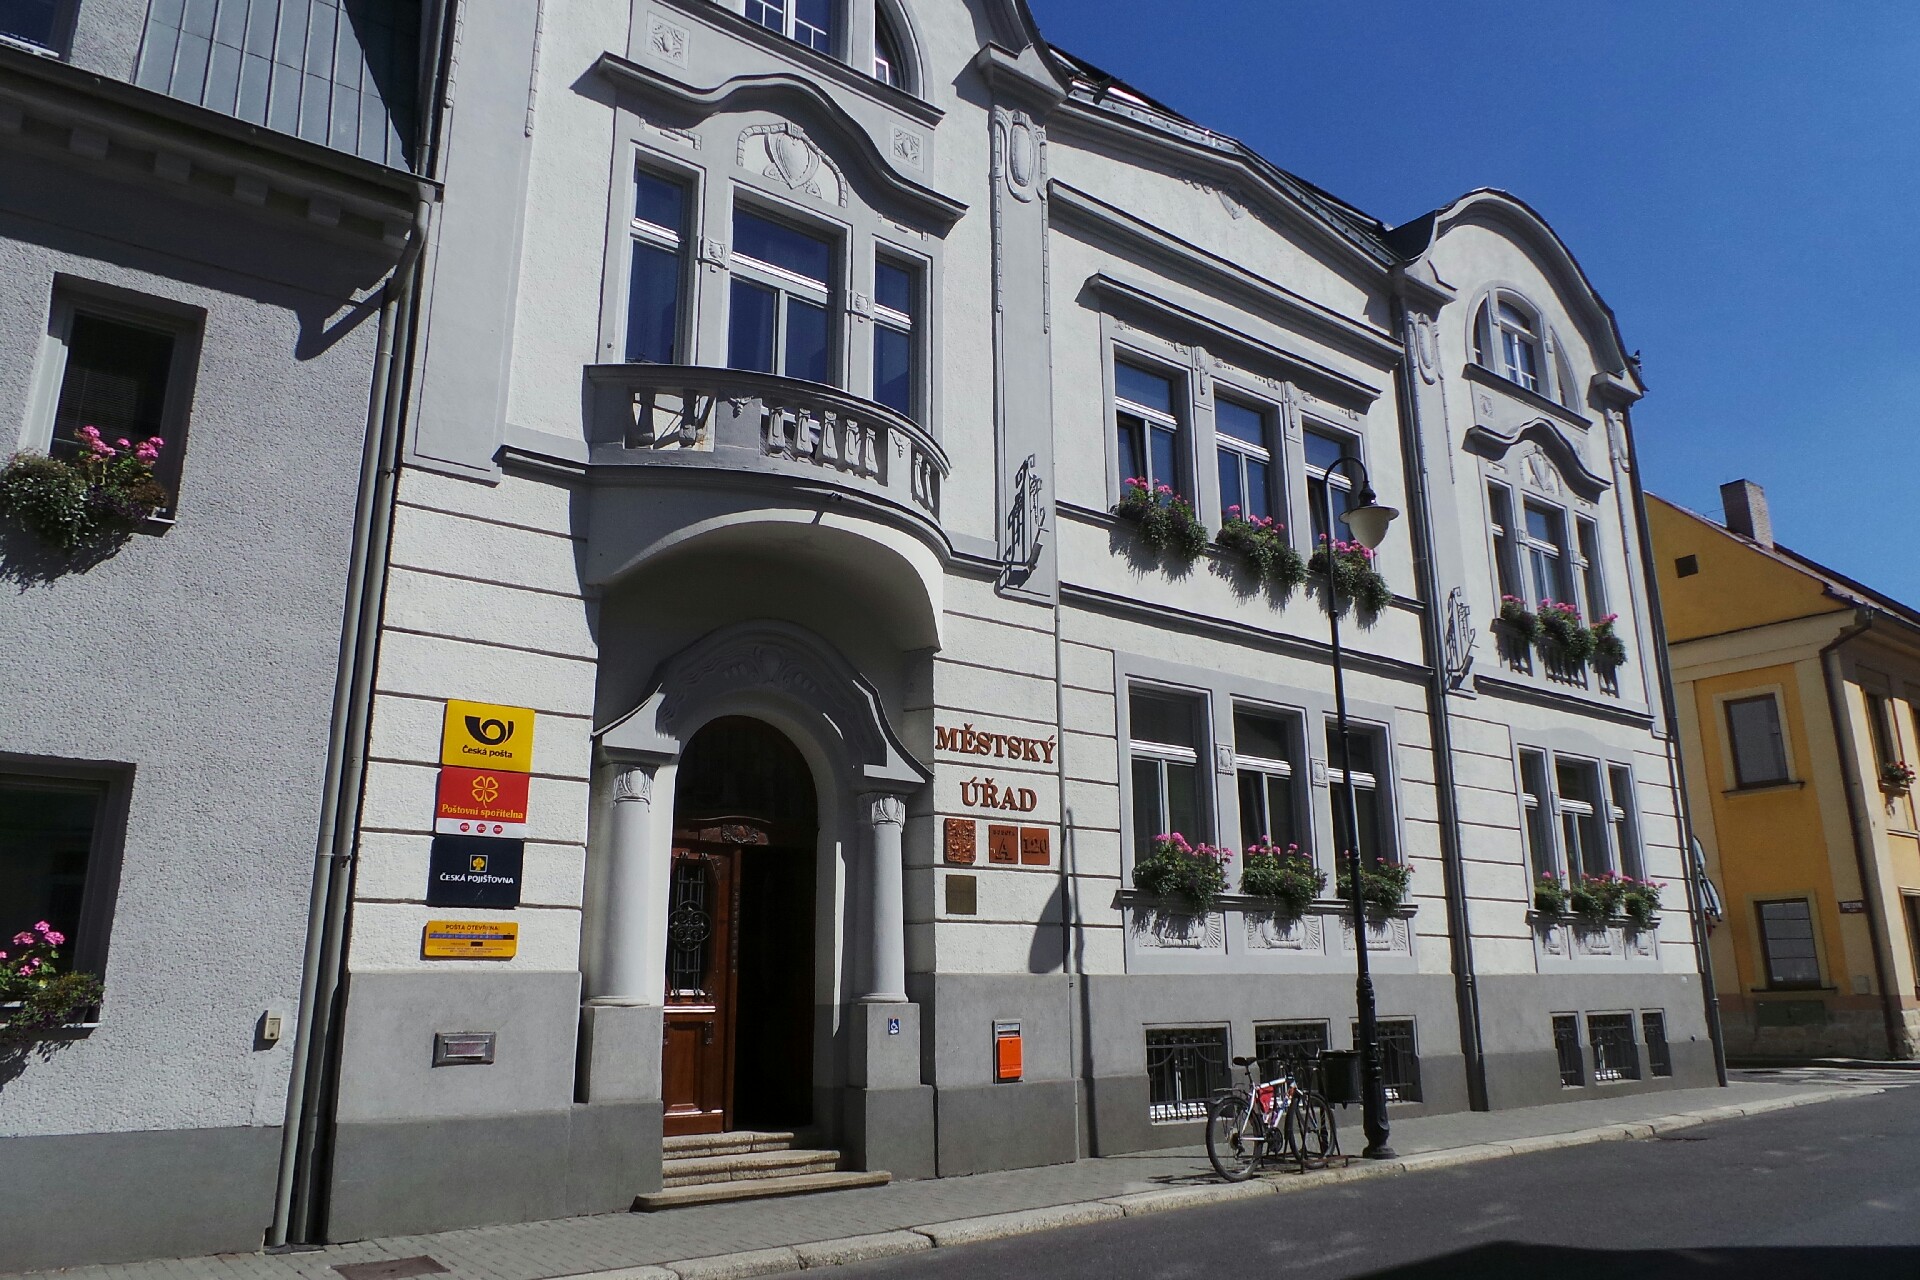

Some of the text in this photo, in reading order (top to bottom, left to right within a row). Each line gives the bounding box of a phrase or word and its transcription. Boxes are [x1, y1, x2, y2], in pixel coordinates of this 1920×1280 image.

[462, 745, 513, 758] Česká pošta
[935, 723, 1056, 764] MĚSTSKÝ
[960, 776, 1038, 812] ÚŘAD
[442, 804, 523, 819] Poštovní spořitelna
[1023, 837, 1047, 854] 120
[440, 872, 514, 884] ČESKÁ POJIŠŤOVNA
